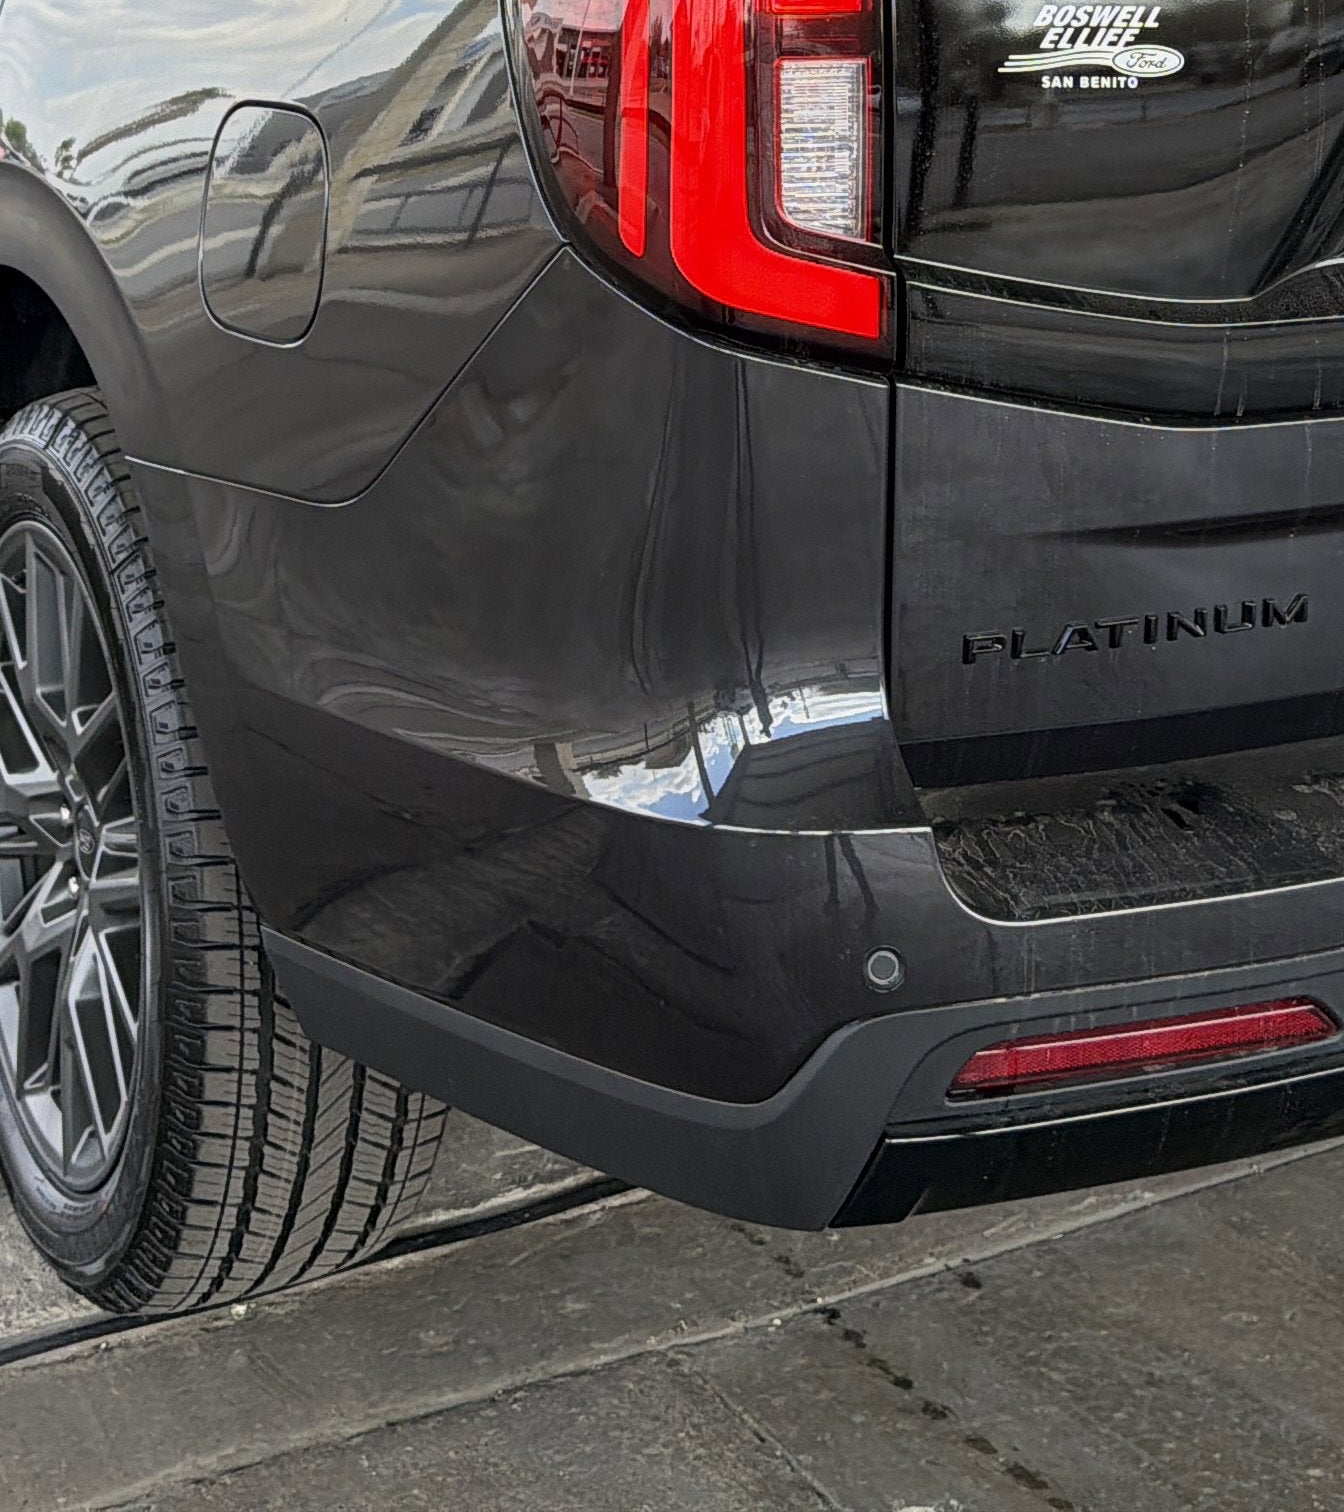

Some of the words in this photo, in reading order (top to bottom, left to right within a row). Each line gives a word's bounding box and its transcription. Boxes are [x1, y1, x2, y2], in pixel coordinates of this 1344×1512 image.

[1033, 4, 1162, 28] BOSWELL
[1039, 27, 1141, 49] ELLIFF
[1126, 51, 1168, 69] Ford
[1041, 75, 1074, 89] SAN
[1079, 75, 1139, 89] BENITO
[962, 593, 1309, 664] PLATINUM
